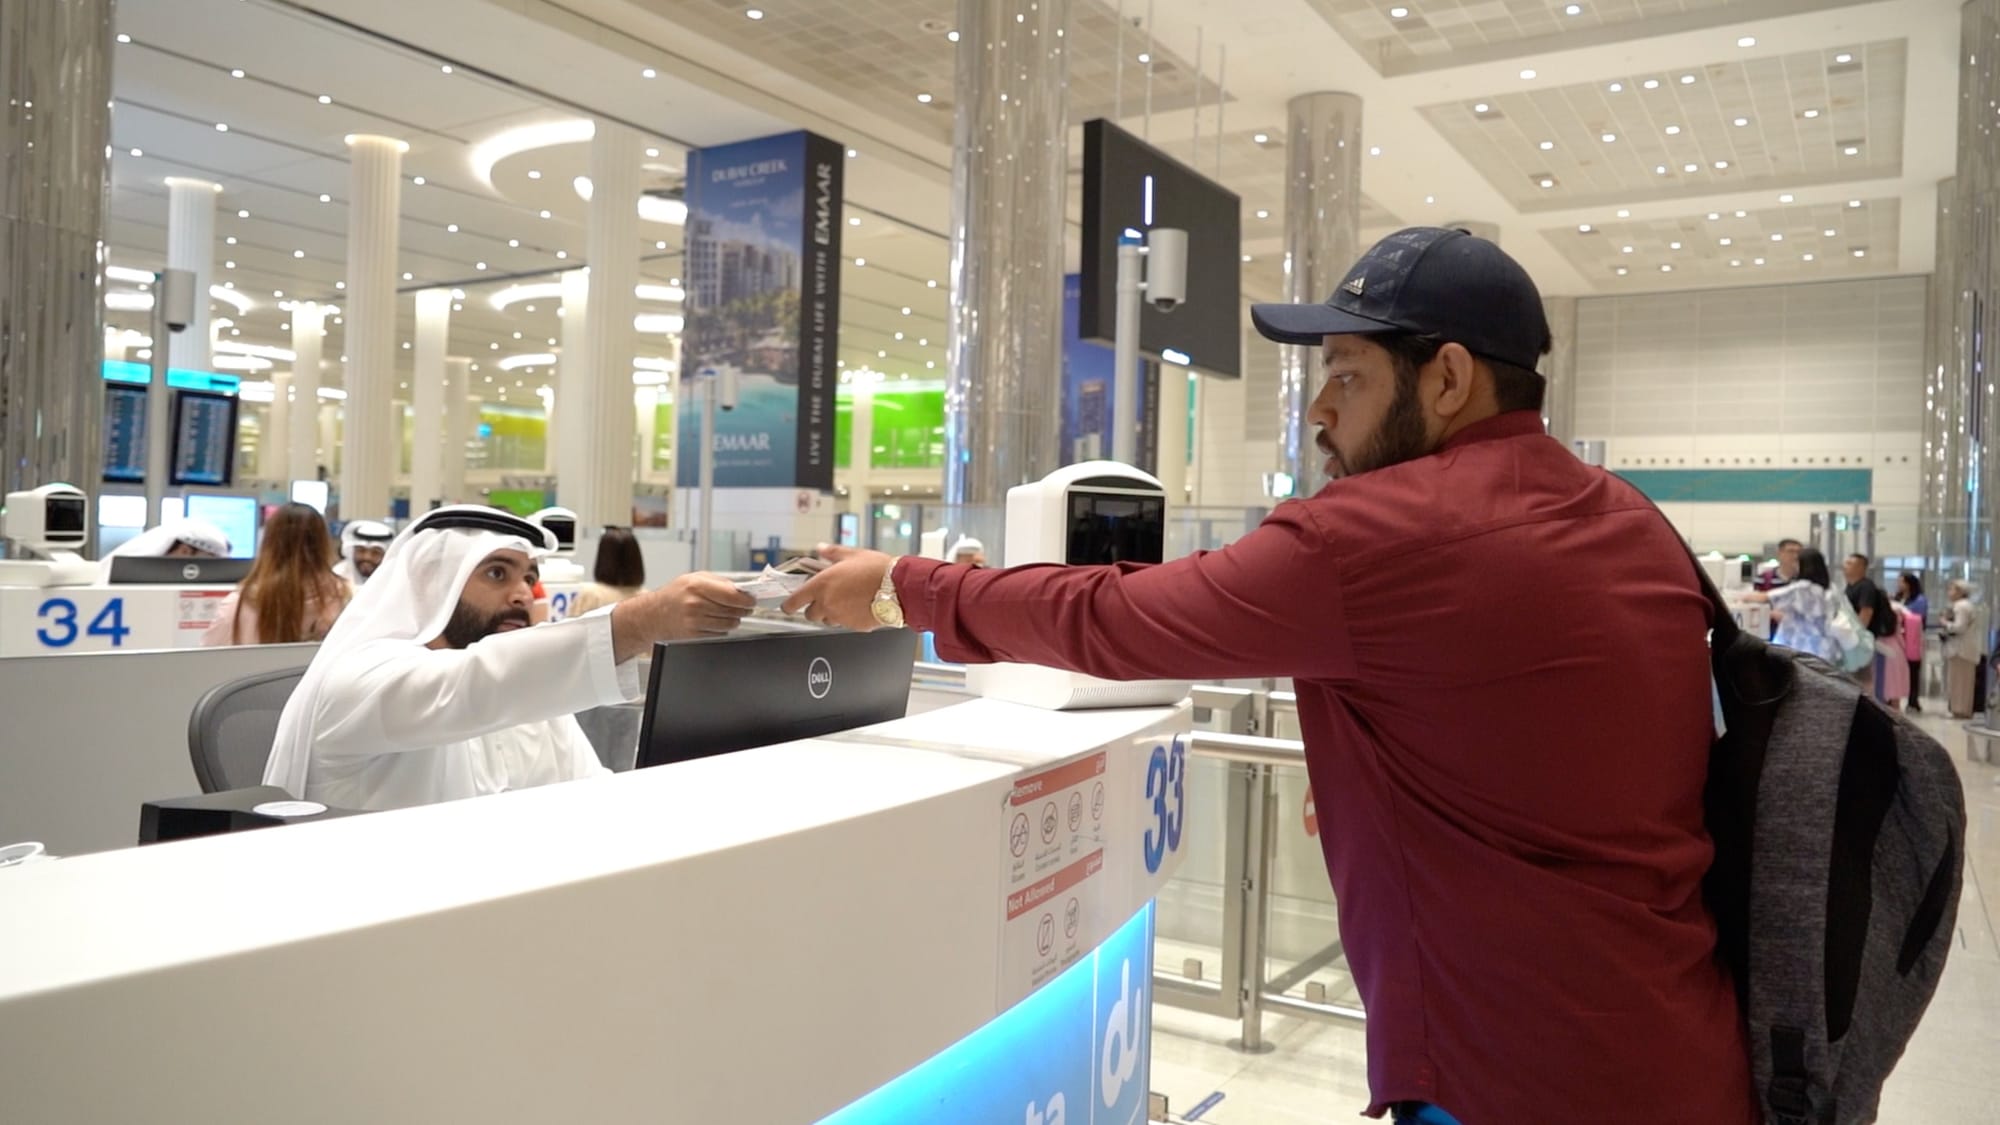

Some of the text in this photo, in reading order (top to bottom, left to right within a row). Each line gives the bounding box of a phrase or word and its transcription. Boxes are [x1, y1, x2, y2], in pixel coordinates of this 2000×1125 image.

[712, 164, 748, 183] DUBAI
[750, 159, 788, 177] CREEK
[808, 163, 832, 465] LIVE THE DUBAI LIFE WITH EMAAR
[713, 432, 771, 452] EMAAR
[37, 597, 130, 648] 34
[551, 592, 578, 623] 3
[811, 672, 829, 684] DELL
[1144, 733, 1185, 874] 33
[1008, 895, 1024, 914] Not
[1024, 876, 1056, 905] Allowed
[1102, 957, 1142, 1108] du
